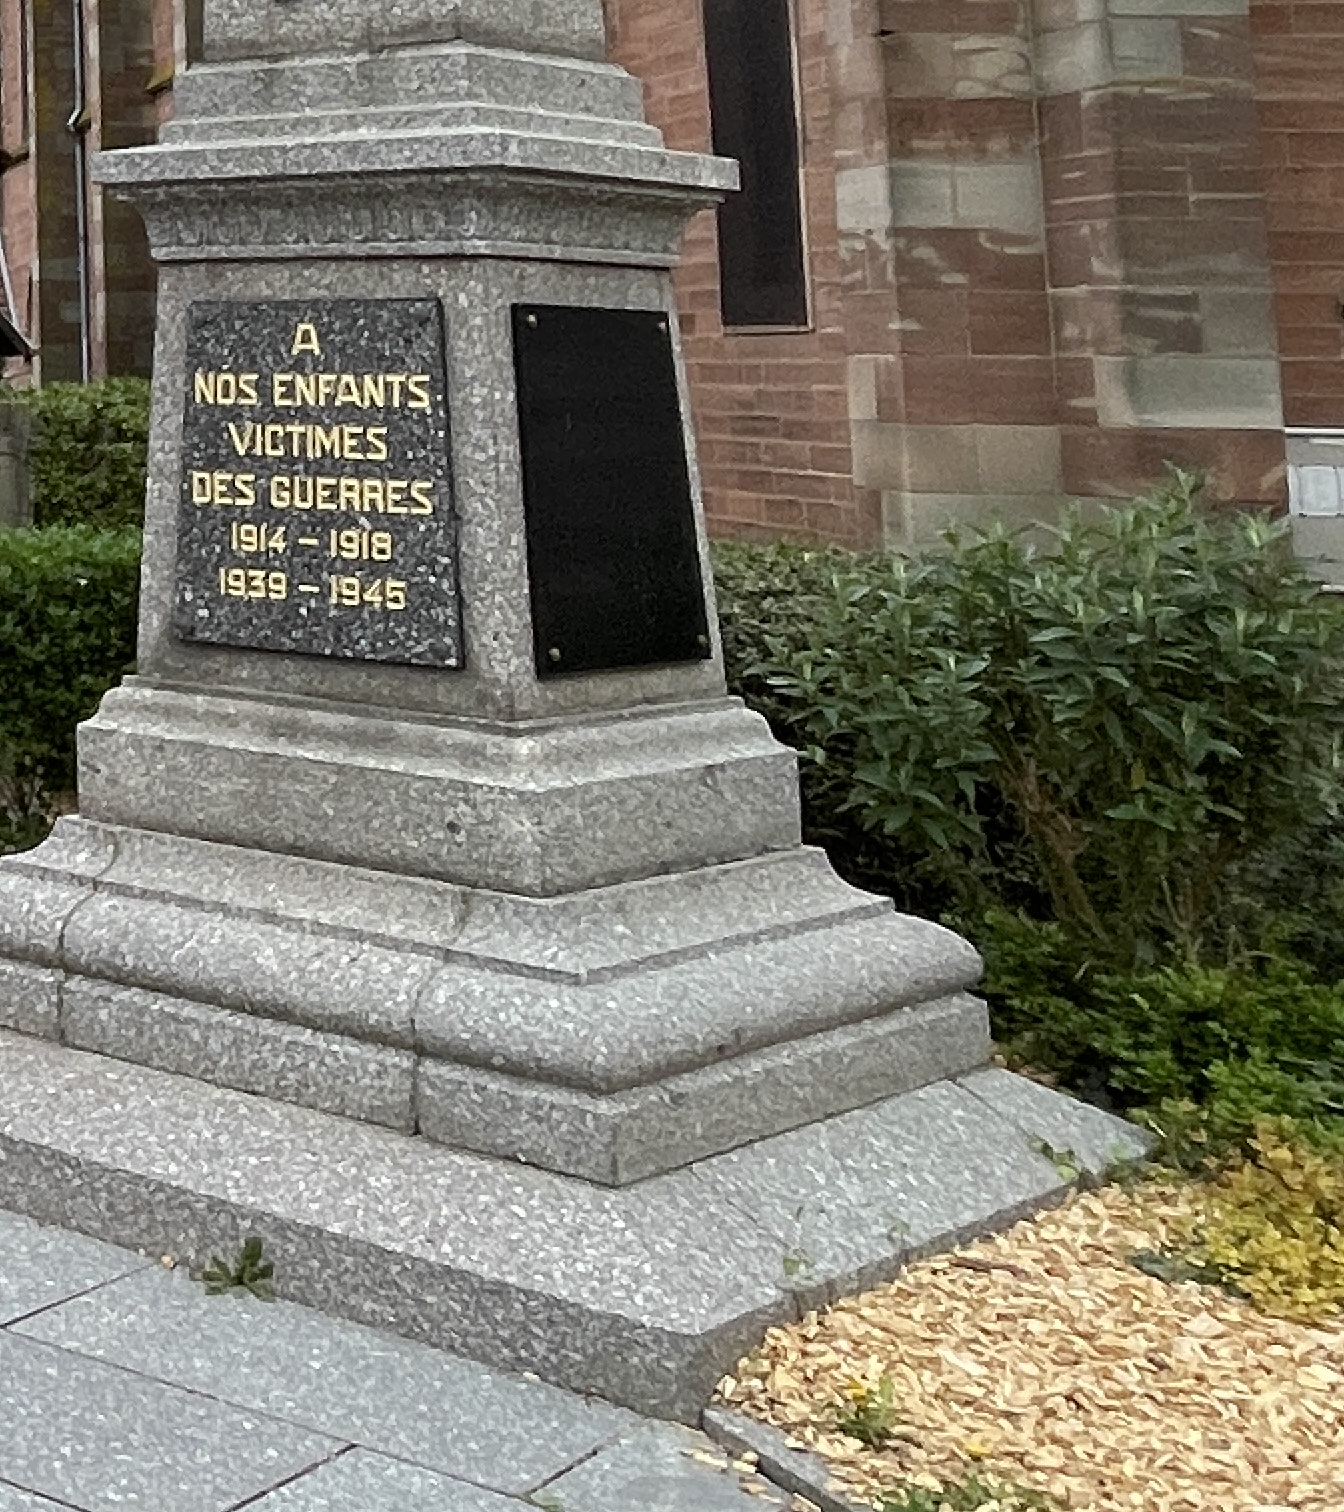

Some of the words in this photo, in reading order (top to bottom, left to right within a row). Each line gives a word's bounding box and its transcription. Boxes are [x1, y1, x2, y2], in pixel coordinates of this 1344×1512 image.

[290, 322, 321, 356] A
[194, 371, 259, 405] NOS
[272, 373, 430, 409] ENFANTS
[229, 422, 388, 460] VICTIMES
[192, 471, 255, 506] DES
[270, 475, 434, 515] GUERRES
[230, 522, 287, 552] 1914
[330, 528, 393, 561] 1918
[219, 567, 287, 601] 1939
[330, 575, 407, 610] 1945
